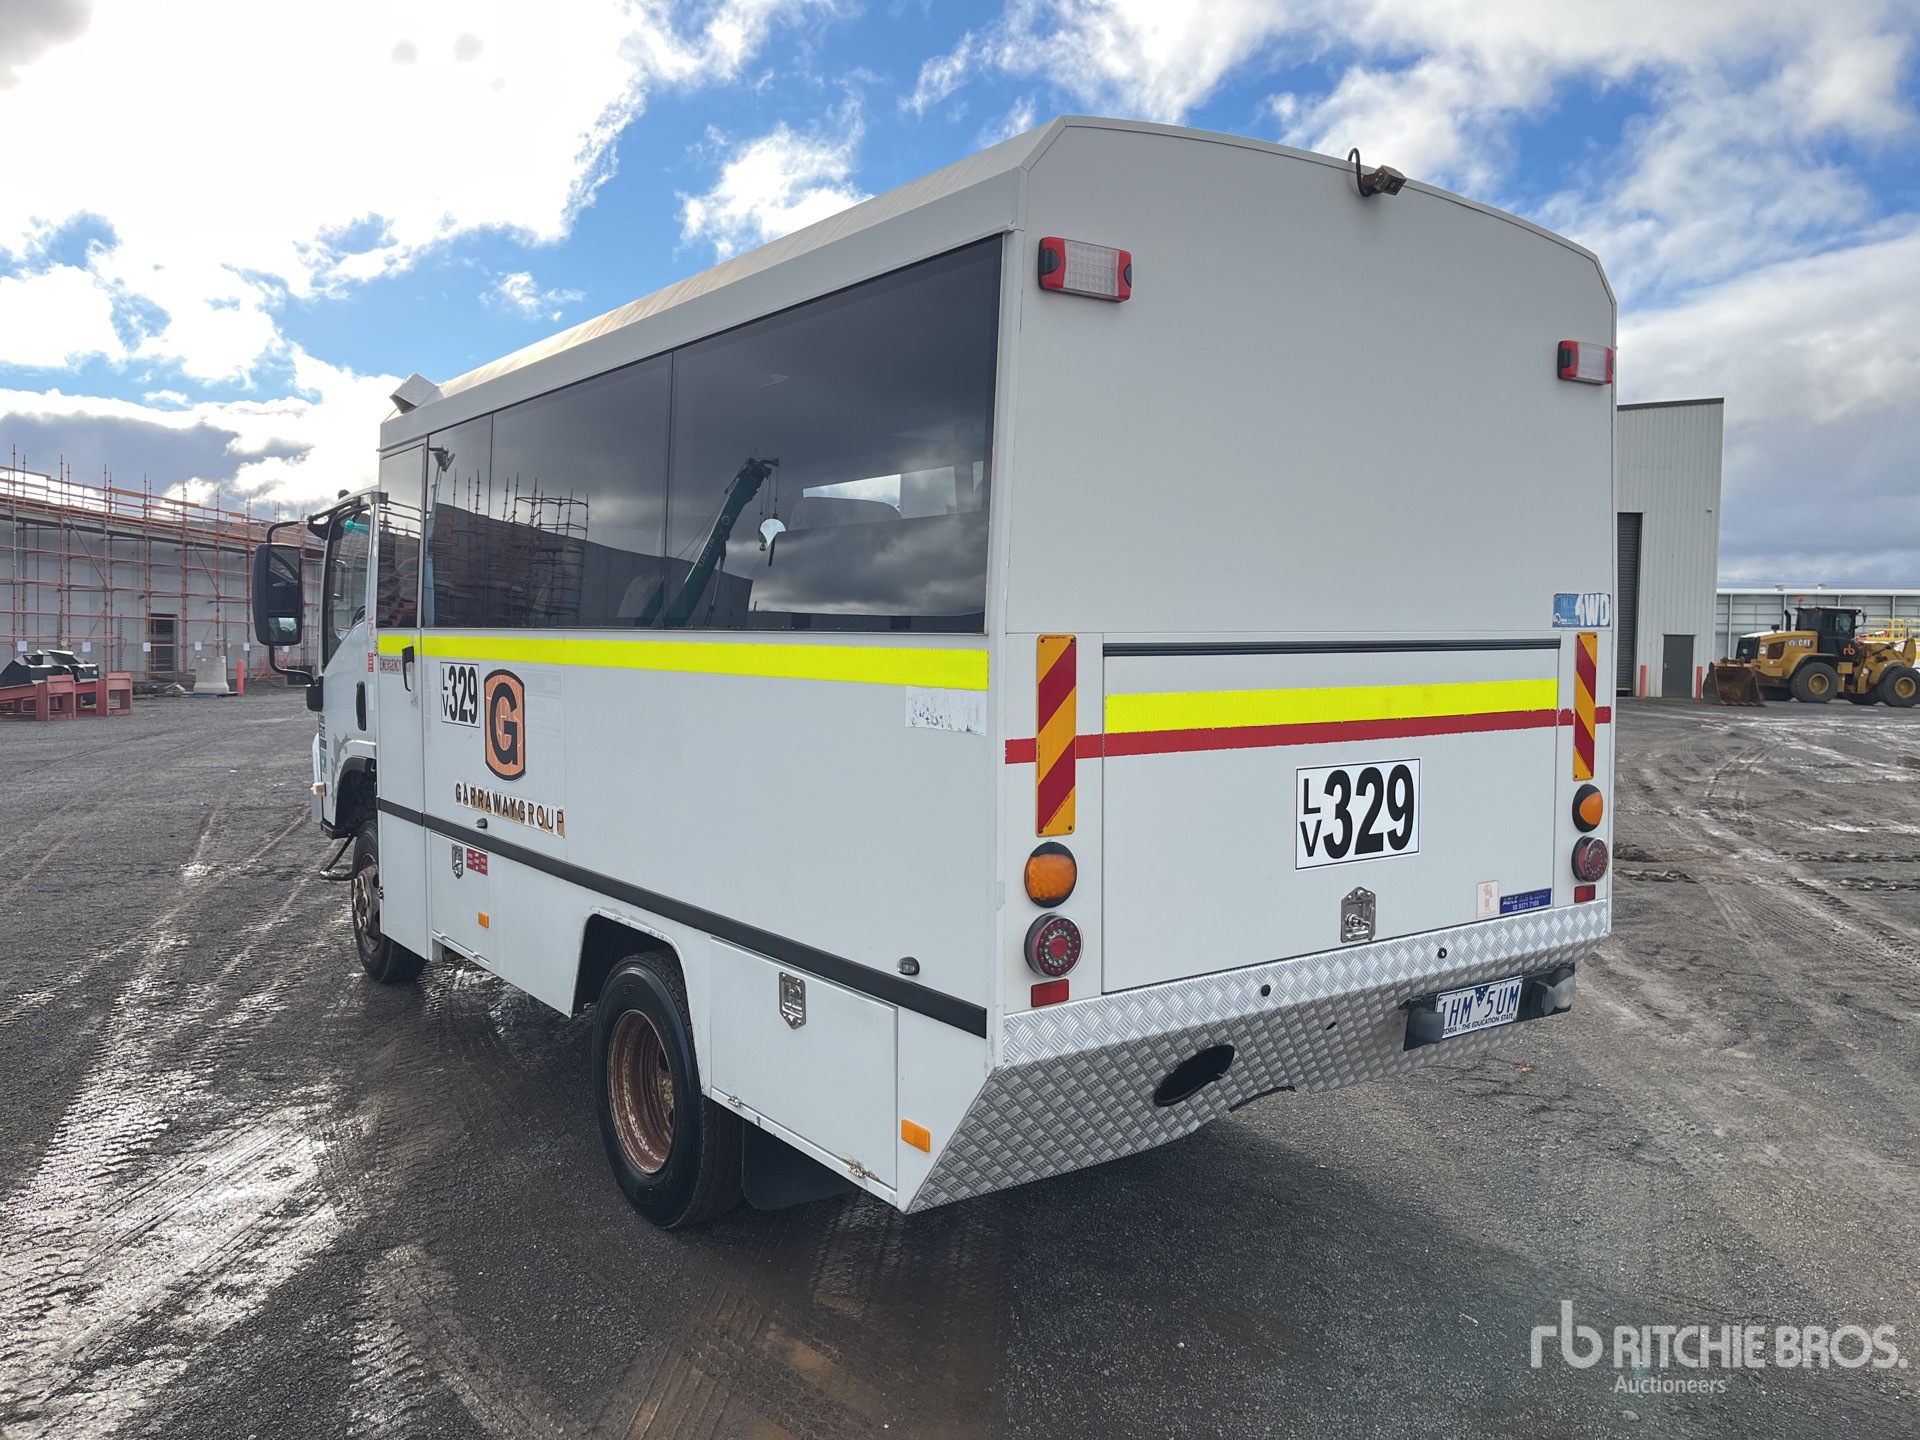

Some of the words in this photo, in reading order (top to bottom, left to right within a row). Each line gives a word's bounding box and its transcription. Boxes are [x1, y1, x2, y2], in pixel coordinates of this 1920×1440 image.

[1575, 595, 1609, 626] 4WD
[1799, 639, 1811, 647] CAT
[1843, 644, 1855, 655] rb
[449, 665, 478, 724] 329
[490, 682, 518, 765] G
[1323, 764, 1415, 859] 329
[1483, 984, 1519, 1018] 5UM
[1471, 1015, 1500, 1027] EDUCATION
[1500, 1012, 1514, 1020] STATE
